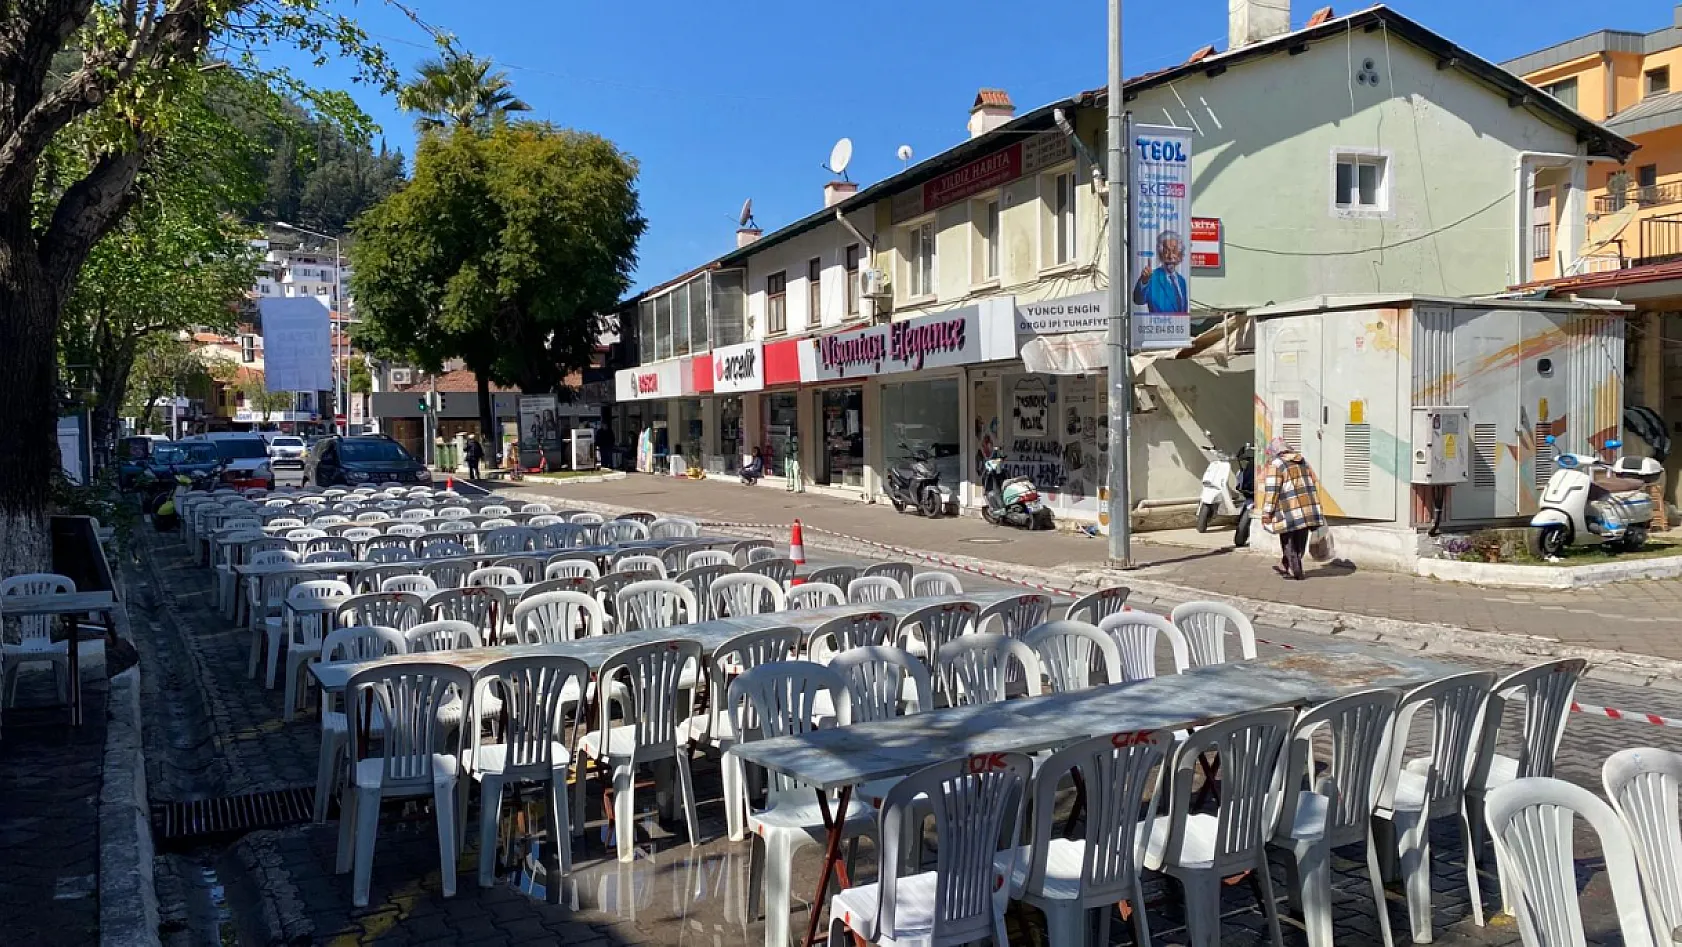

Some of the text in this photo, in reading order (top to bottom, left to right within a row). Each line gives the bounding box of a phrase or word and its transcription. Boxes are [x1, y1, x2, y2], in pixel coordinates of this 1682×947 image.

[1136, 138, 1187, 162] TEOL
[1027, 302, 1101, 316] YÜNCÜ ENGİN
[889, 318, 966, 371] Elegance
[724, 347, 756, 387] arçelik
